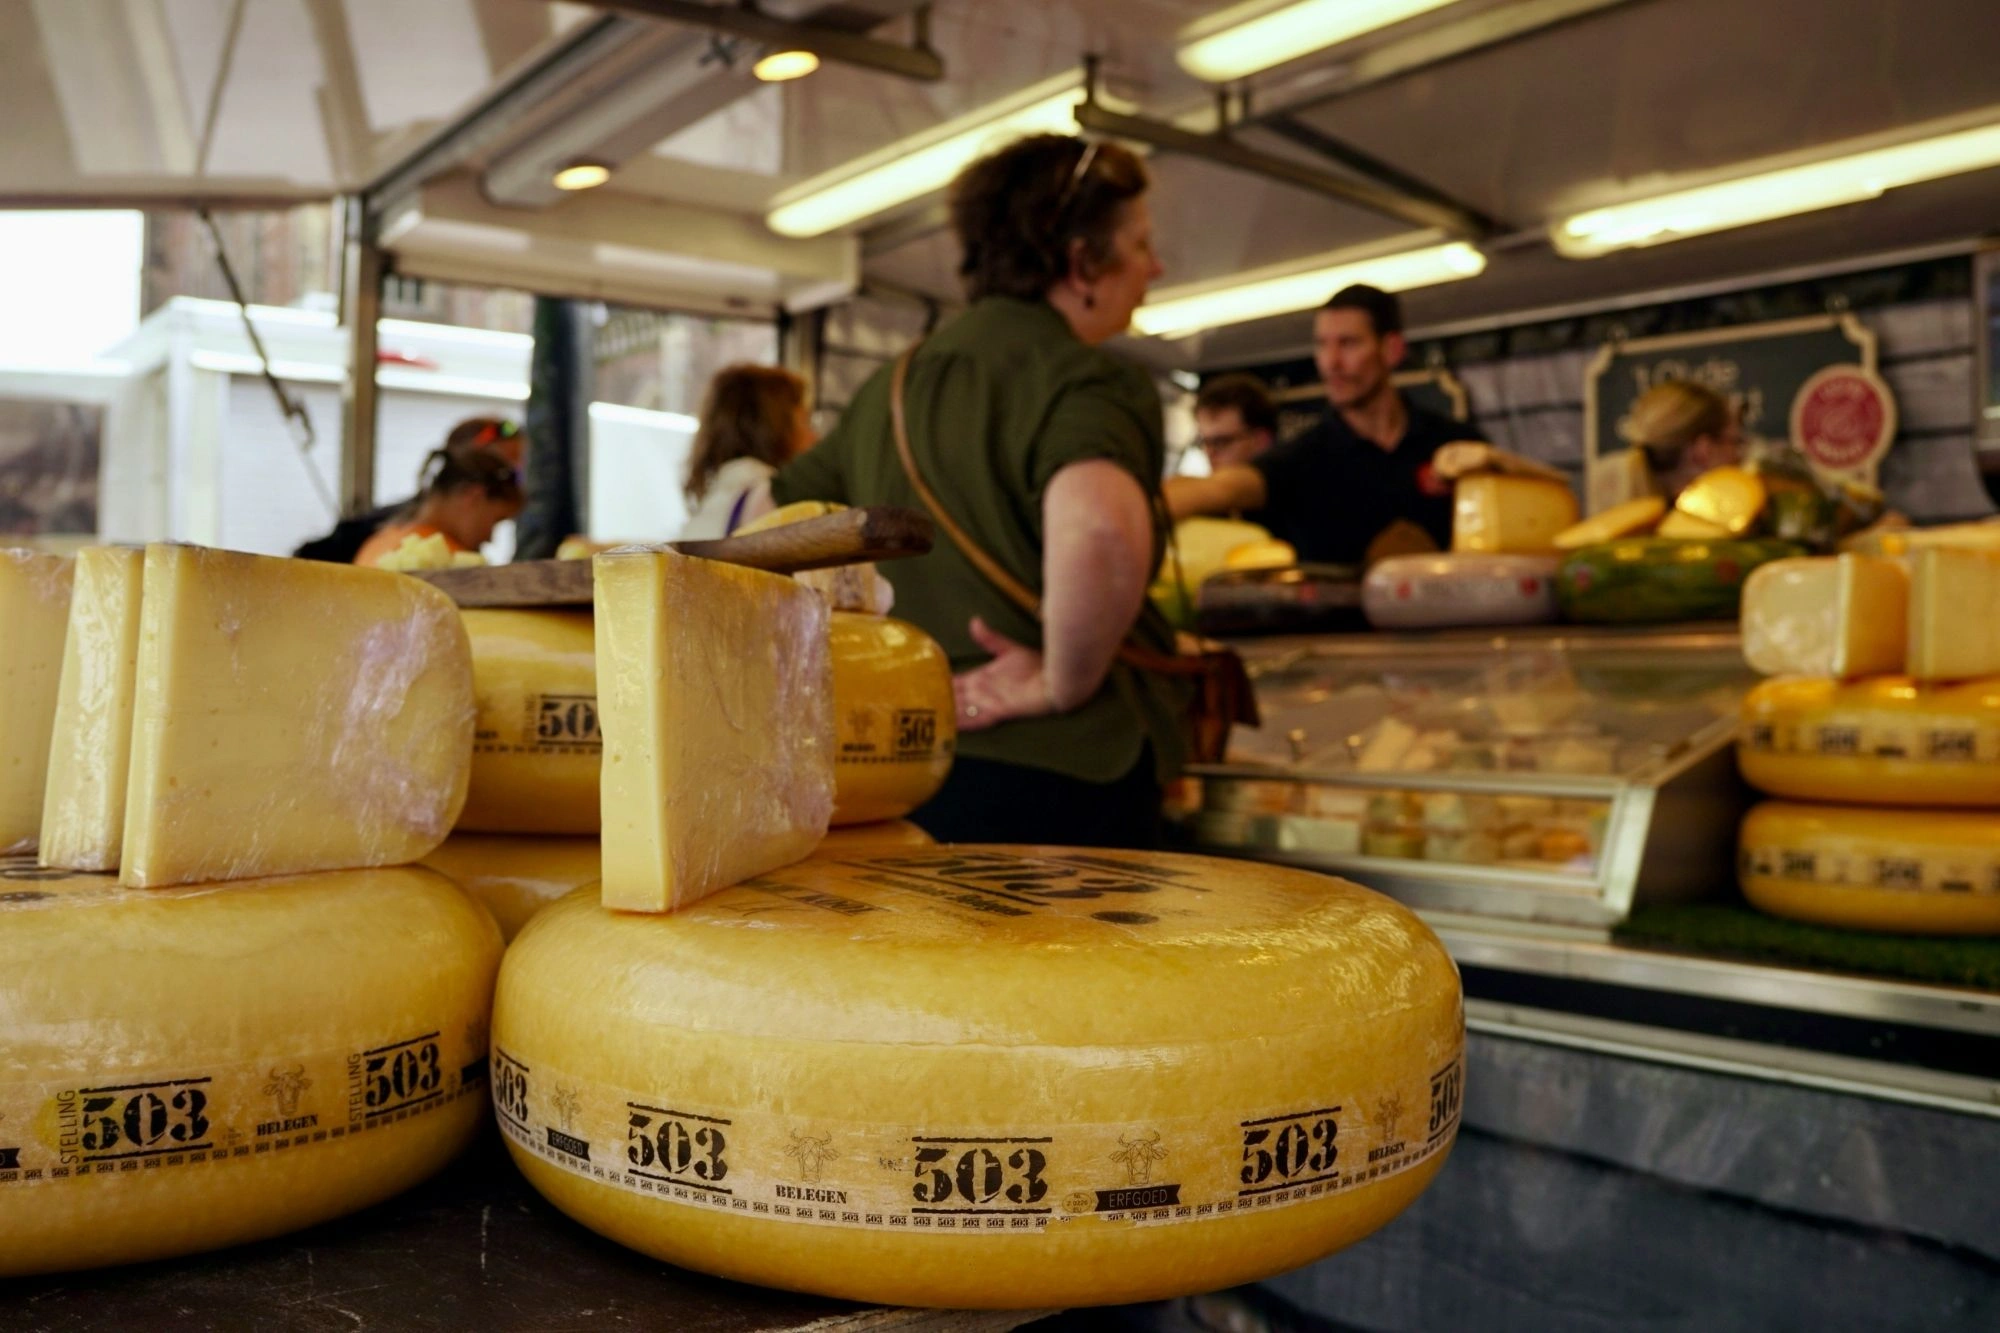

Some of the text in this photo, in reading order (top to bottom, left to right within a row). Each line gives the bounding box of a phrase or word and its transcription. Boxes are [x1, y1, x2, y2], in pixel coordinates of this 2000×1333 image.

[538, 702, 602, 738] 50
[347, 1053, 363, 1122] STELLING
[365, 1043, 441, 1107] 503
[495, 1056, 528, 1122] 503
[57, 1090, 79, 1164] STELLING
[82, 1089, 210, 1150] 503
[256, 1114, 318, 1136] BELEGEN
[628, 1112, 728, 1181] 503
[913, 1146, 1048, 1204] 503
[1241, 1119, 1338, 1184] 503
[1368, 1141, 1405, 1163] BELEGEN
[674, 1187, 688, 1198] 503
[693, 1191, 706, 1202] 503
[712, 1195, 727, 1206] 503
[732, 1199, 747, 1209] 503
[753, 1202, 769, 1213] 503
[774, 1204, 791, 1216] 503
[796, 1207, 813, 1219] 503
[819, 1209, 836, 1221] 503
[842, 1212, 859, 1223] 503
[865, 1214, 883, 1224] 503
[889, 1215, 907, 1225] 503
[913, 1216, 931, 1227] 503
[938, 1217, 956, 1227] 503
[962, 1218, 980, 1228] 503
[986, 1218, 1004, 1228] 503
[1011, 1218, 1029, 1228] 503
[1153, 1209, 1169, 1219] 503
[1175, 1206, 1191, 1217] 503
[1197, 1203, 1212, 1215] 503
[1218, 1200, 1233, 1211] 503
[1238, 1197, 1252, 1209] 503
[1257, 1195, 1271, 1206] 503
[1275, 1191, 1289, 1202] 503
[1293, 1188, 1306, 1198] 503
[775, 1184, 848, 1204] BELEGEN
[1109, 1189, 1168, 1208] ERFGOED
